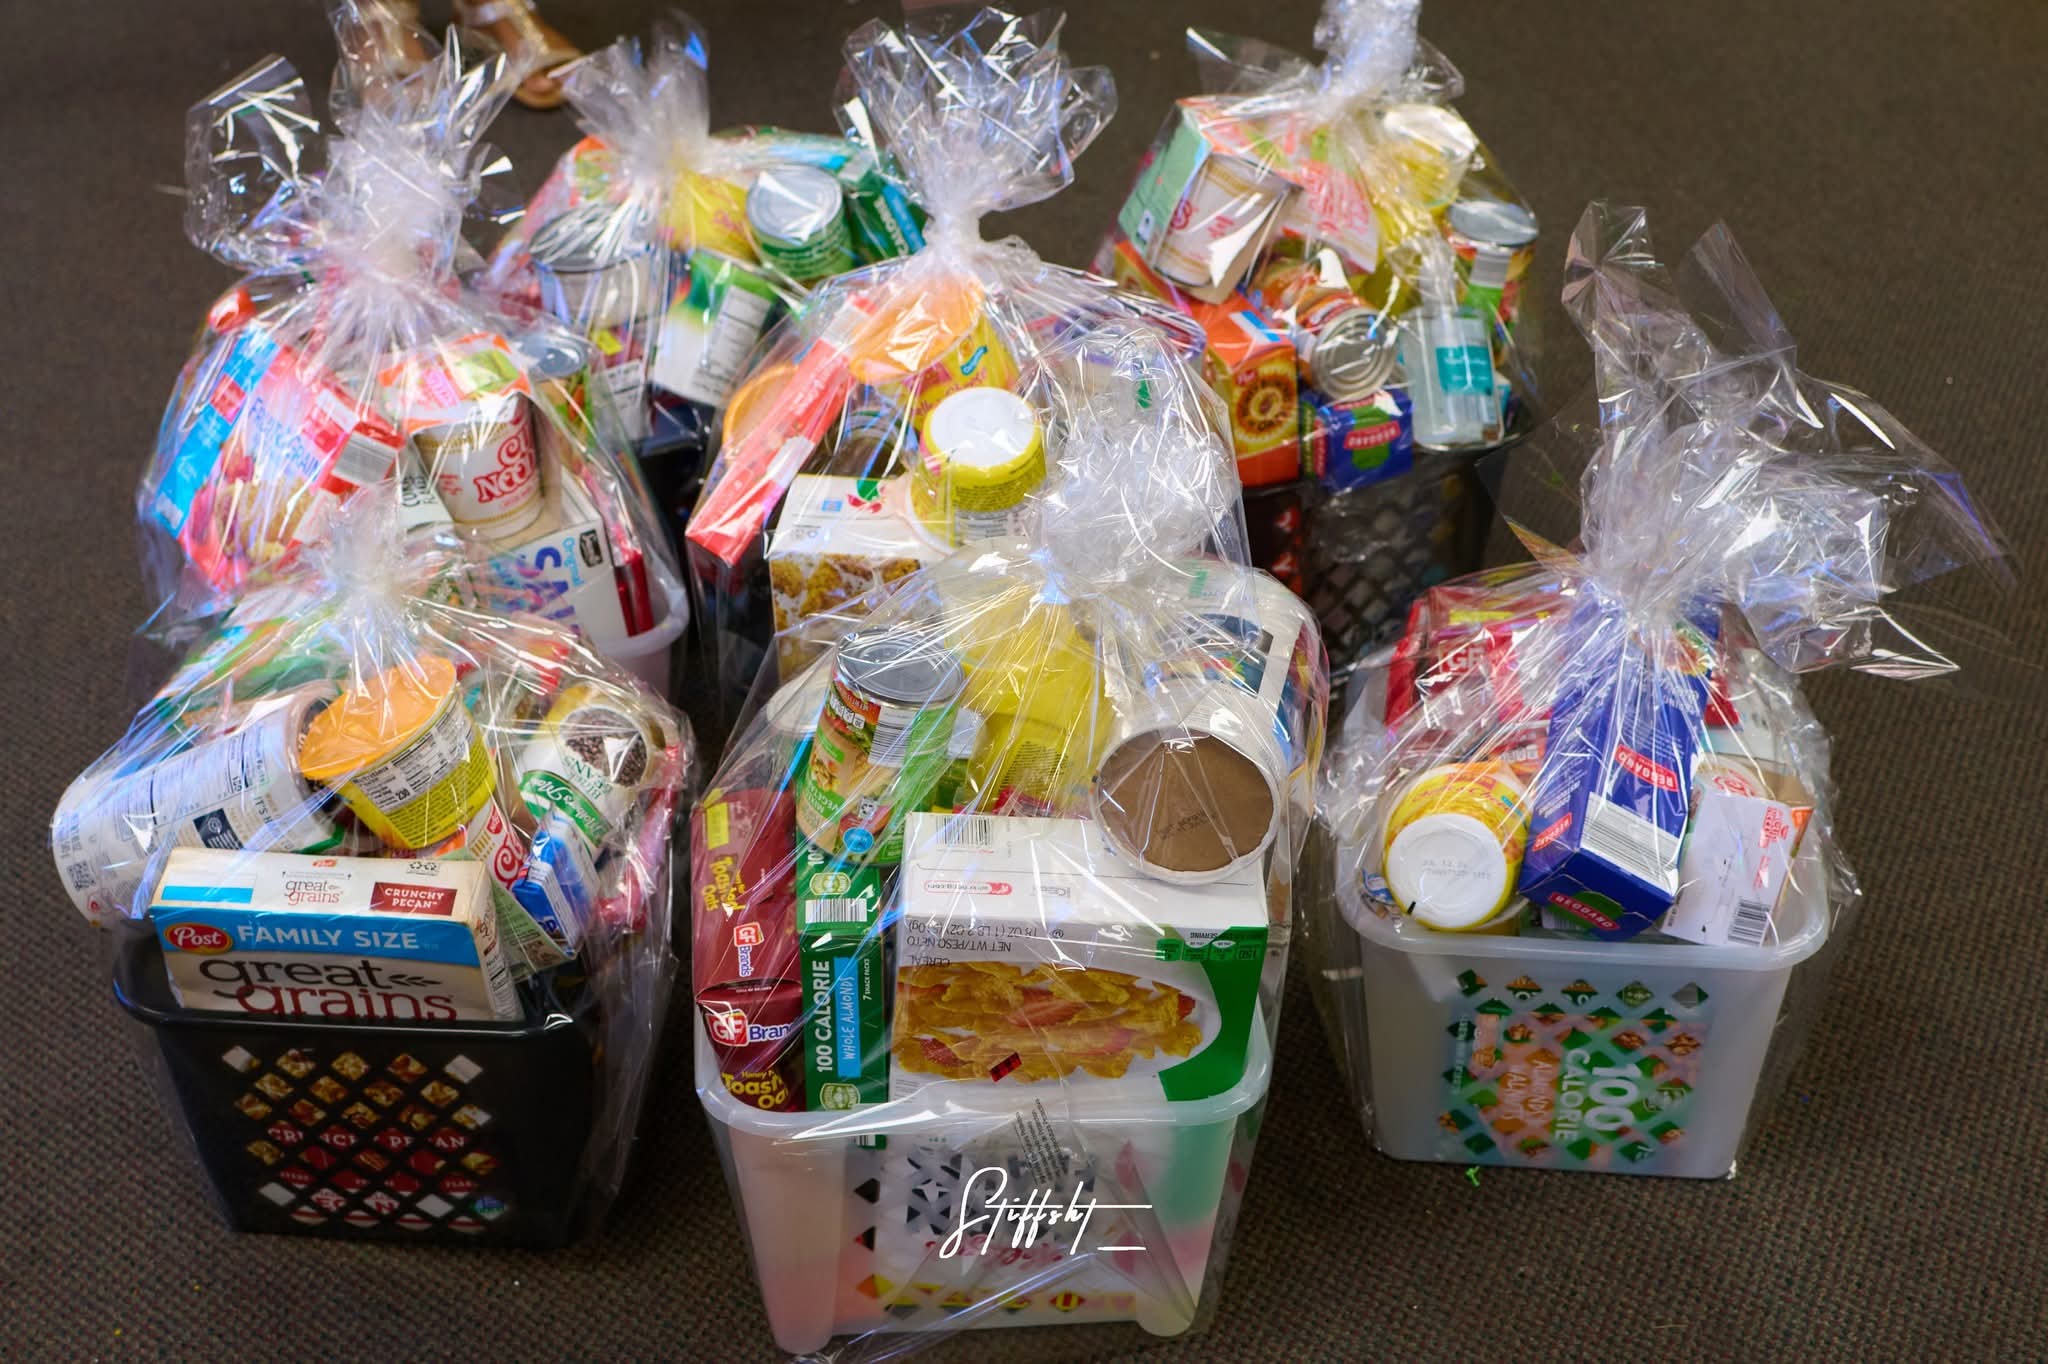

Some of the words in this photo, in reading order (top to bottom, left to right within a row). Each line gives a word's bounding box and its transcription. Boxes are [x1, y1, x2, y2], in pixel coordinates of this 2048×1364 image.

[285, 880, 331, 899] great
[288, 889, 341, 906] grains
[384, 887, 445, 901] CRUNCHY
[174, 927, 221, 947] Post
[237, 926, 341, 947] FAMILY
[354, 930, 419, 950] SIZE
[739, 926, 758, 944] GF
[991, 940, 1012, 952] NET
[200, 958, 393, 998] great
[863, 957, 871, 977] PACKS
[863, 977, 872, 995] SNACK
[812, 959, 832, 1042] CALORIE
[840, 975, 855, 1026] ALMONDS
[749, 1023, 793, 1041] Bran
[842, 1026, 856, 1060] WHOLE
[816, 1044, 833, 1073] 100
[1554, 1047, 1591, 1142] CALORIE
[1584, 1063, 1642, 1131] 100
